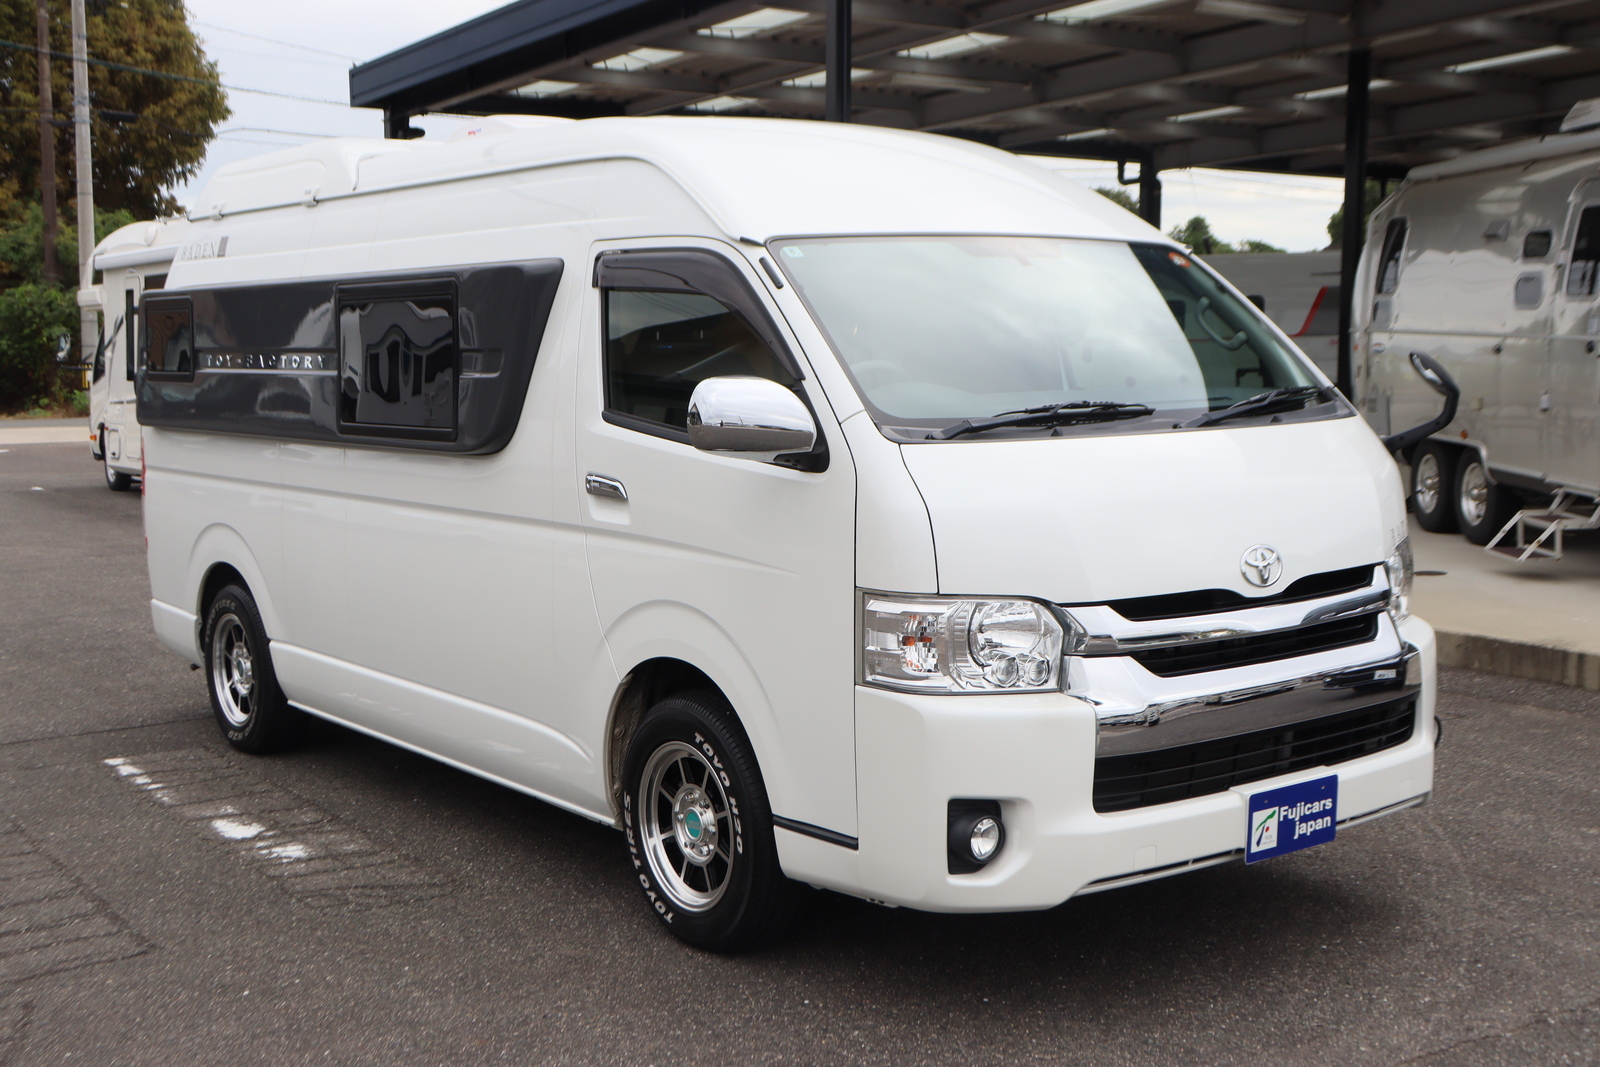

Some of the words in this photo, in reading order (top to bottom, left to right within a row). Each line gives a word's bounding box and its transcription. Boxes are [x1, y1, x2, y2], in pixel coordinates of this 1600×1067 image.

[694, 732, 731, 788] TOYO
[624, 791, 642, 870] TIRES
[1280, 798, 1333, 822] Fujicars
[1293, 816, 1332, 840] japan
[639, 873, 674, 924] TOYO
